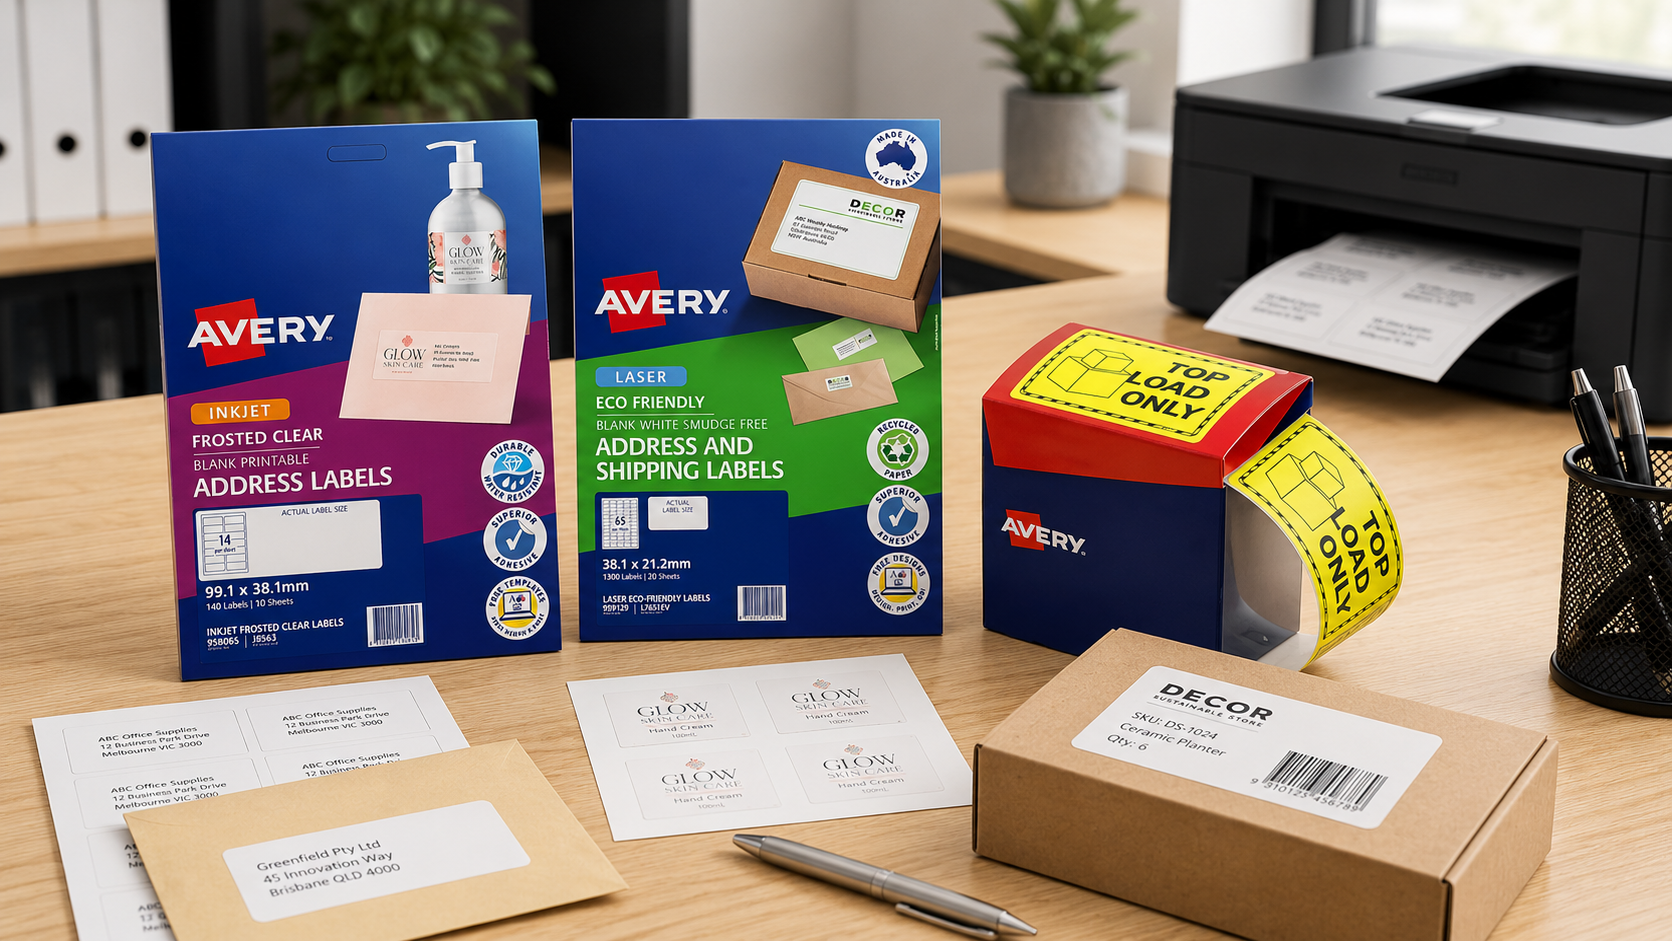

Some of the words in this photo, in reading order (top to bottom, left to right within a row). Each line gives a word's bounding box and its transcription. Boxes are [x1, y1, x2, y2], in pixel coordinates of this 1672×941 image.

[876, 131, 902, 143] MADE
[873, 170, 920, 186] AUSTRALIA
[850, 199, 906, 218] DECOR
[448, 246, 484, 258] GLOW
[594, 290, 730, 314] AVERY
[187, 314, 335, 348] AVERY
[383, 348, 426, 360] GLOW
[616, 370, 666, 383] LASER
[1167, 362, 1230, 382] TOP
[1126, 371, 1210, 399] LOAD
[596, 396, 627, 409] ECO
[633, 396, 705, 409] FRIENDLY
[1120, 391, 1205, 420] ONLY
[209, 404, 271, 420] INKJET
[596, 420, 635, 430] BLANK
[640, 420, 679, 430] WHITE
[683, 419, 735, 430] SMUDGE
[740, 418, 768, 430] FREE
[877, 420, 920, 434] RECYCLED
[192, 431, 267, 448] FROSTED
[272, 428, 323, 443] CLEAR
[596, 437, 698, 456] ADDRESS
[704, 436, 753, 456] AND
[490, 442, 534, 458] DURABLE
[194, 458, 236, 471] BLANK
[241, 453, 309, 468] PRINTABLE
[596, 461, 699, 480] SHIPPING
[707, 460, 784, 480] LABELS
[193, 472, 303, 498] ADDRESS
[311, 466, 393, 490] LABELS
[884, 469, 912, 479] PAPER
[876, 487, 920, 504] SUPERIOR
[281, 508, 310, 516] ACTUAL
[492, 510, 538, 528] SUPERIOR
[219, 534, 231, 546] 14
[877, 530, 920, 545] ADHESIVE
[1001, 517, 1086, 554] AVERY
[1362, 510, 1389, 576] TOP
[1330, 506, 1369, 594] LOAD
[494, 552, 538, 569] ADHESIVE
[602, 559, 627, 570] 38.1
[631, 561, 639, 569] x
[642, 558, 691, 570] 21.2mm
[1320, 535, 1351, 614] ONLY
[205, 585, 234, 599] 99.1
[239, 586, 248, 596] x
[252, 581, 309, 595] 38.1mm
[603, 595, 627, 603] LASER
[683, 594, 710, 602] LABELS
[206, 602, 221, 611] 140
[223, 600, 249, 610] Labels
[256, 599, 266, 607] 10
[268, 597, 294, 606] Sheets
[206, 626, 237, 636] INKJET
[240, 623, 280, 634] FROSTED
[282, 620, 310, 631] CLEAR
[312, 618, 344, 628] LABELS
[792, 688, 860, 703] GLOW
[1160, 683, 1273, 721] DECOR
[637, 701, 708, 717] GLOW
[795, 703, 827, 711] SKIN
[832, 699, 868, 708] CARE
[836, 709, 870, 717] Cream
[1153, 695, 1223, 717] SUSTAINABLE
[1228, 715, 1263, 727] STORE
[282, 714, 302, 722] ABC
[304, 710, 335, 719] Office
[336, 706, 377, 716] Supplies
[299, 718, 340, 727] Business
[365, 711, 390, 719] Drive
[676, 713, 714, 721] CARE
[122, 731, 153, 740] Office
[155, 726, 198, 737] Supplies
[288, 725, 340, 736] Melbourne
[361, 719, 383, 727] 3000
[649, 726, 676, 734] Hand
[1132, 712, 1163, 725] SKU:
[1164, 720, 1218, 740] DS-1024
[115, 738, 157, 748] Business
[1107, 734, 1136, 747] Qty:
[1138, 743, 1149, 751] 6
[1120, 722, 1175, 743] Ceramic
[1177, 738, 1226, 756] Planter
[101, 746, 156, 758] Melbourne
[158, 743, 176, 751] VIC
[178, 740, 203, 748] 3000
[326, 759, 356, 767] Office
[358, 752, 400, 762] Supplies
[823, 754, 895, 771] GLOW
[662, 768, 736, 786] GLOW
[828, 770, 861, 779] SKIN
[865, 765, 904, 776] CARE
[110, 786, 132, 794] ABC
[135, 781, 167, 790] Office
[170, 776, 214, 787] Supplies
[128, 789, 172, 800] Business
[174, 786, 197, 794] Park
[200, 782, 227, 790] Drive
[665, 785, 698, 793] SKIN
[703, 780, 742, 789] CARE
[838, 781, 866, 789] Hand
[870, 777, 905, 785] Cream
[114, 798, 171, 810] Melbourne
[194, 791, 219, 800] 3000
[674, 796, 703, 804] Hand
[256, 849, 330, 872] Greenfield
[332, 846, 355, 857] Pty
[358, 840, 381, 852] Ltd
[263, 875, 281, 885] 45
[284, 857, 360, 881] Innovation
[362, 851, 394, 864] Way
[269, 877, 330, 898] Brisbane
[333, 871, 363, 885] QLD
[366, 863, 401, 876] 4000
